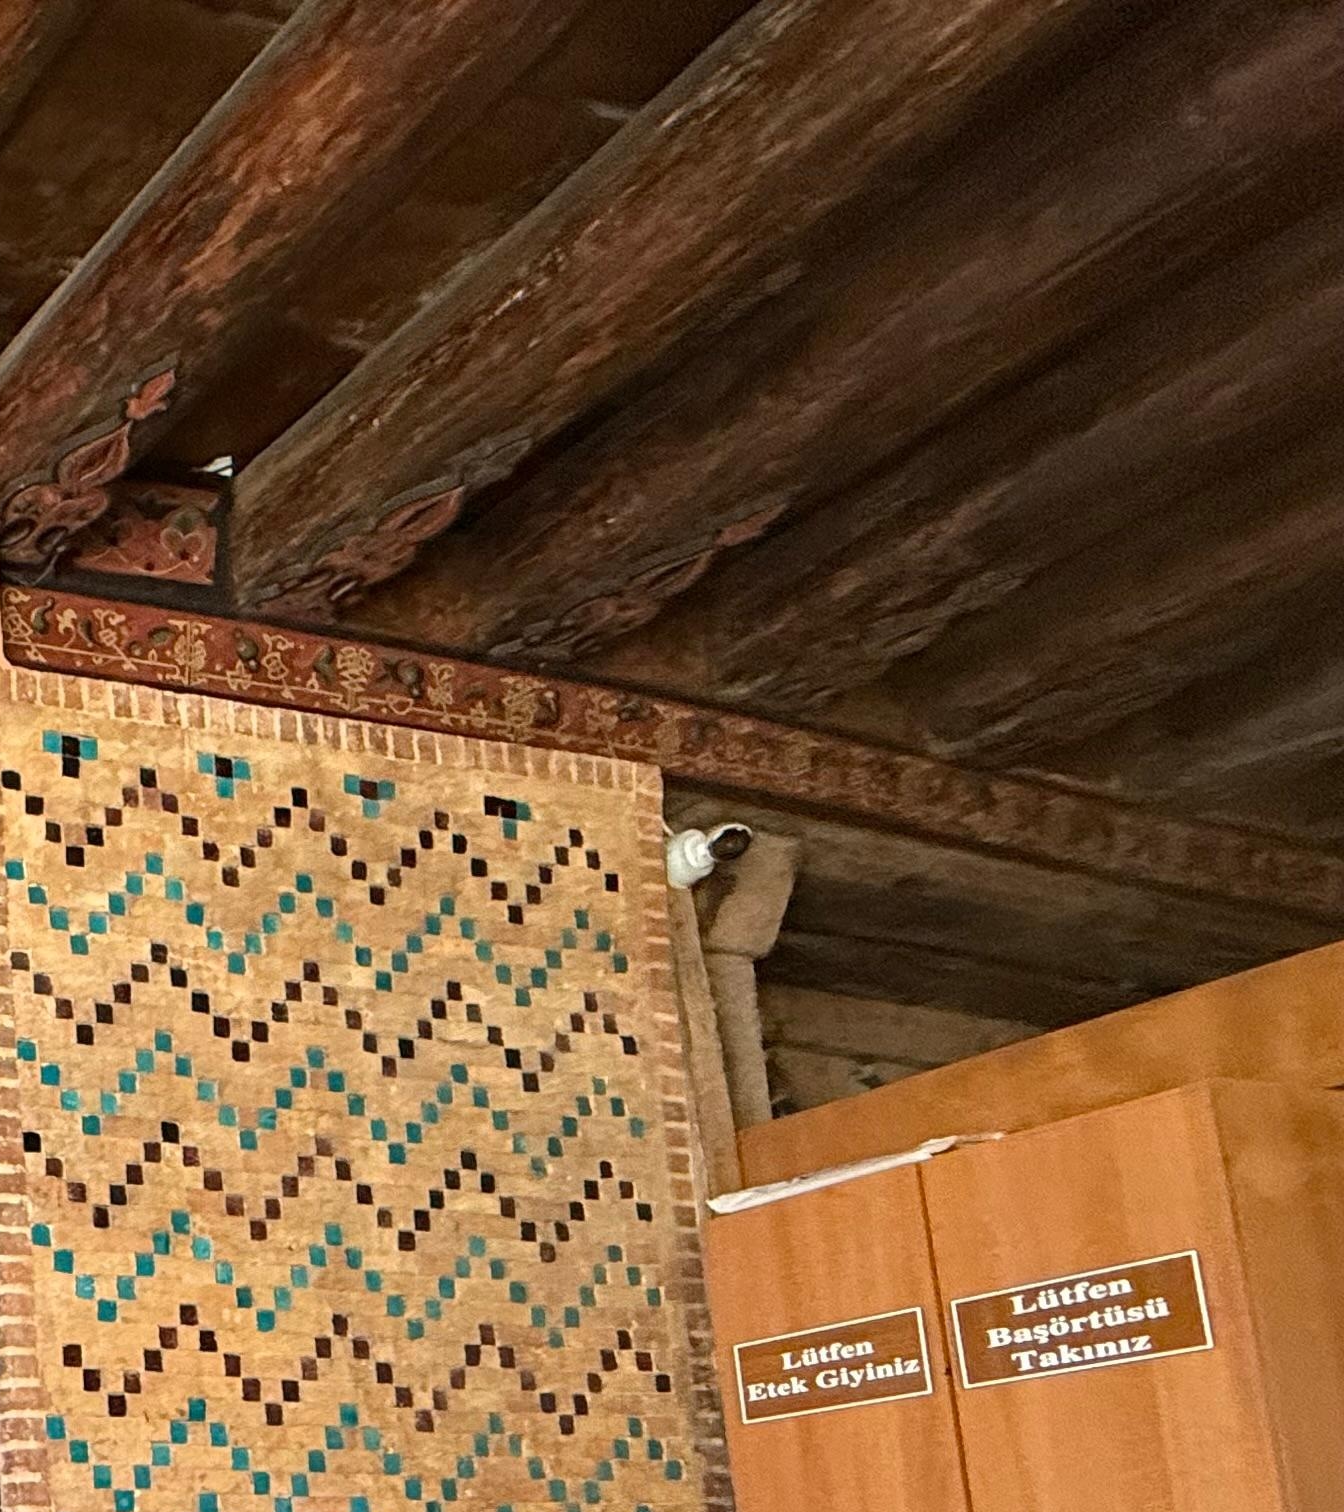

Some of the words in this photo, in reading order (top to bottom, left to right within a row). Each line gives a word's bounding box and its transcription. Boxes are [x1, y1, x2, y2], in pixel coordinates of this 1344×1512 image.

[1011, 1276, 1133, 1316] Lütfen
[986, 1297, 1170, 1350] Başörtüsü
[781, 1338, 874, 1371] Lütfen
[1011, 1334, 1151, 1373] Takınız
[747, 1376, 808, 1404] Etek
[814, 1356, 920, 1391] Giyiniz
